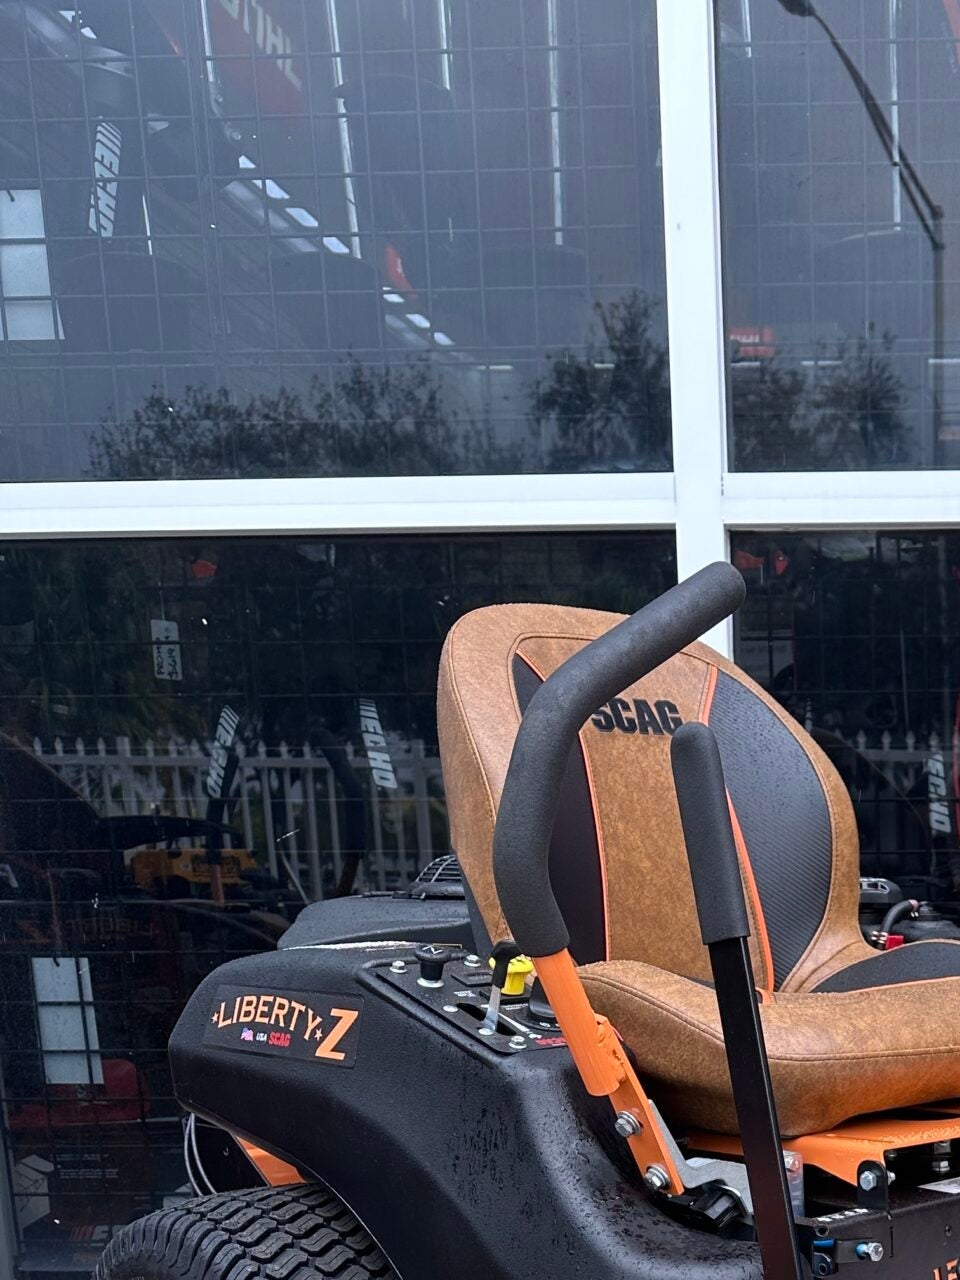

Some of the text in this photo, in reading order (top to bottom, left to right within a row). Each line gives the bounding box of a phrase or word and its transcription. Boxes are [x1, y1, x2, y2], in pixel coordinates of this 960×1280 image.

[88, 140, 120, 238] ECHO
[591, 697, 683, 736] SCAG
[206, 721, 235, 798] ECHO
[361, 717, 398, 789] ECHO
[218, 995, 359, 1061] LIBERTY Z
[256, 1031, 291, 1047] USA SCAG
